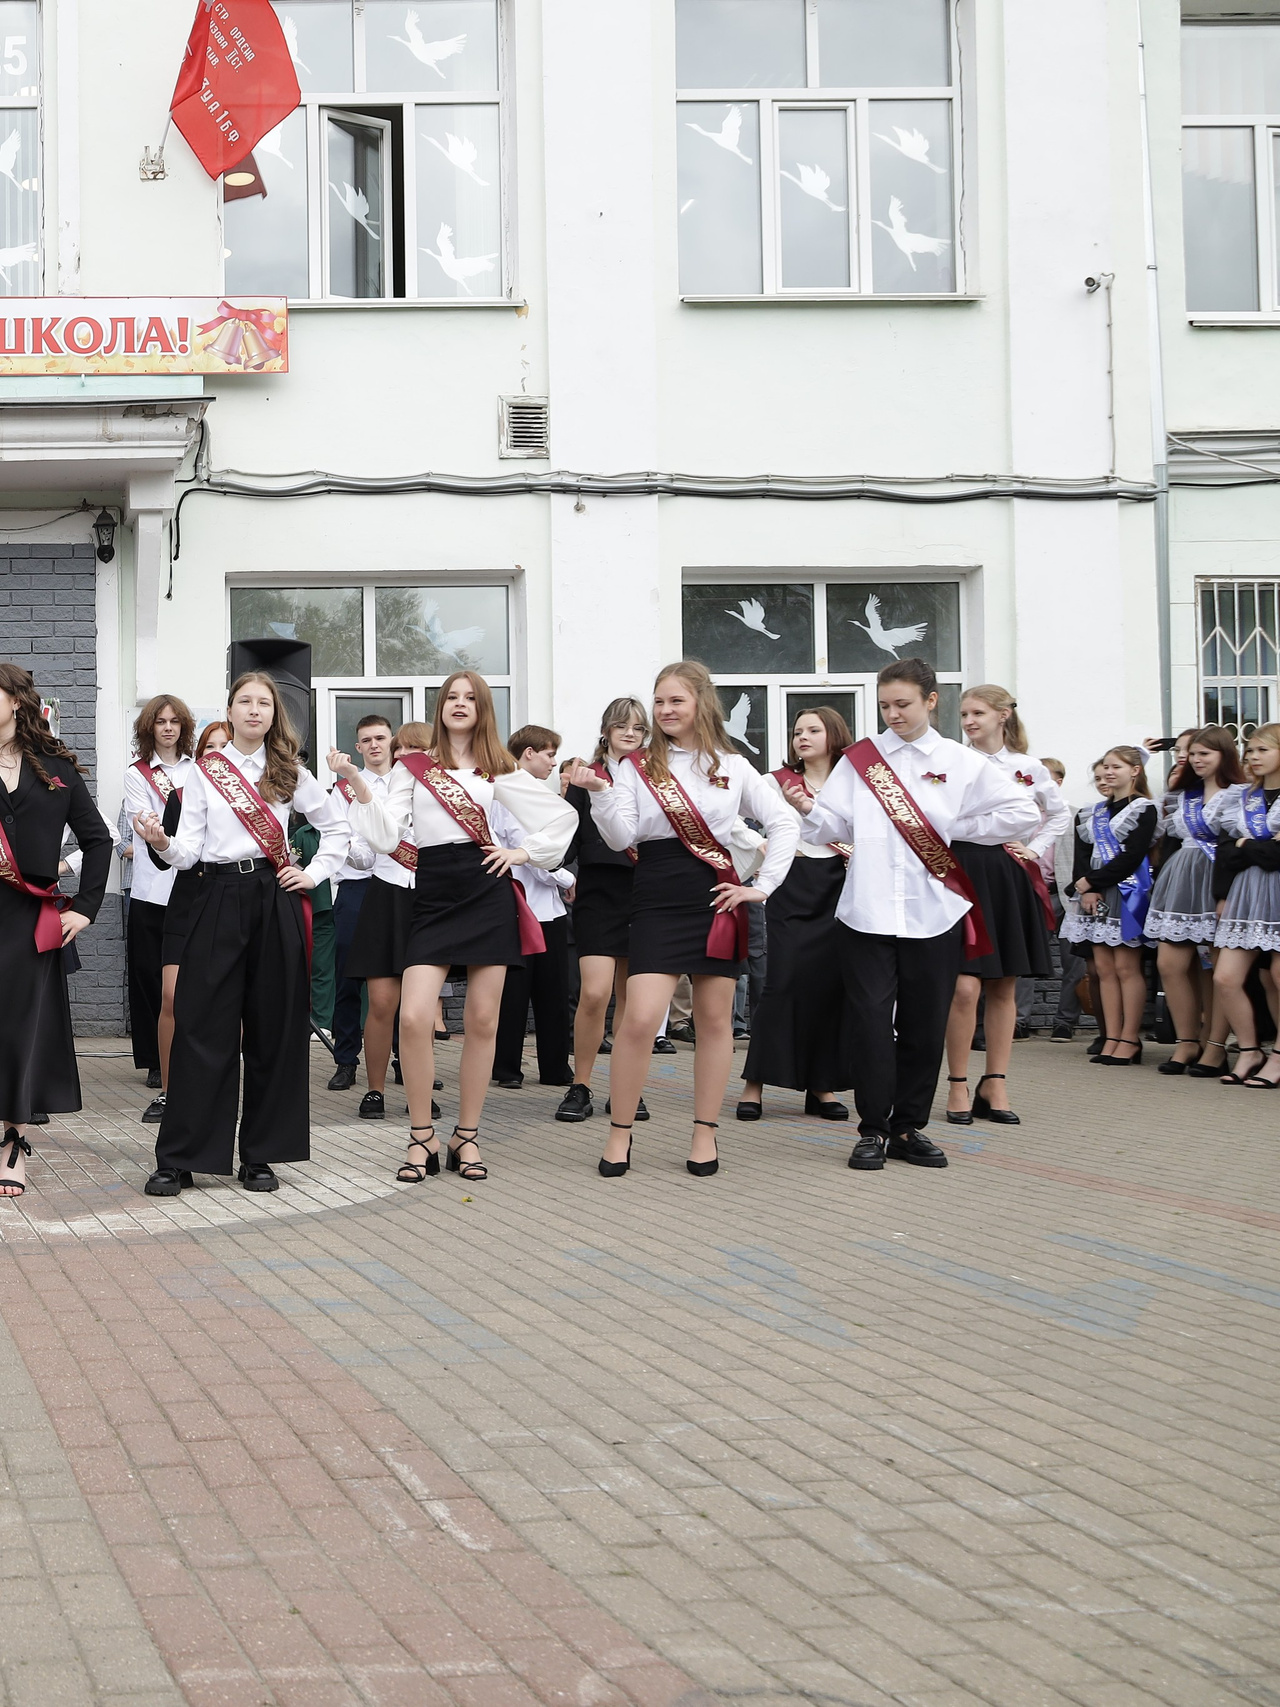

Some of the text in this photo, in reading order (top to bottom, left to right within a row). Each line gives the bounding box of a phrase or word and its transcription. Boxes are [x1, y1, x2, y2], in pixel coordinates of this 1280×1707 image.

[229, 26, 256, 62] ОРДЕНА
[215, 771, 273, 839] Выпускник
[878, 782, 957, 878] Выпускник 2025
